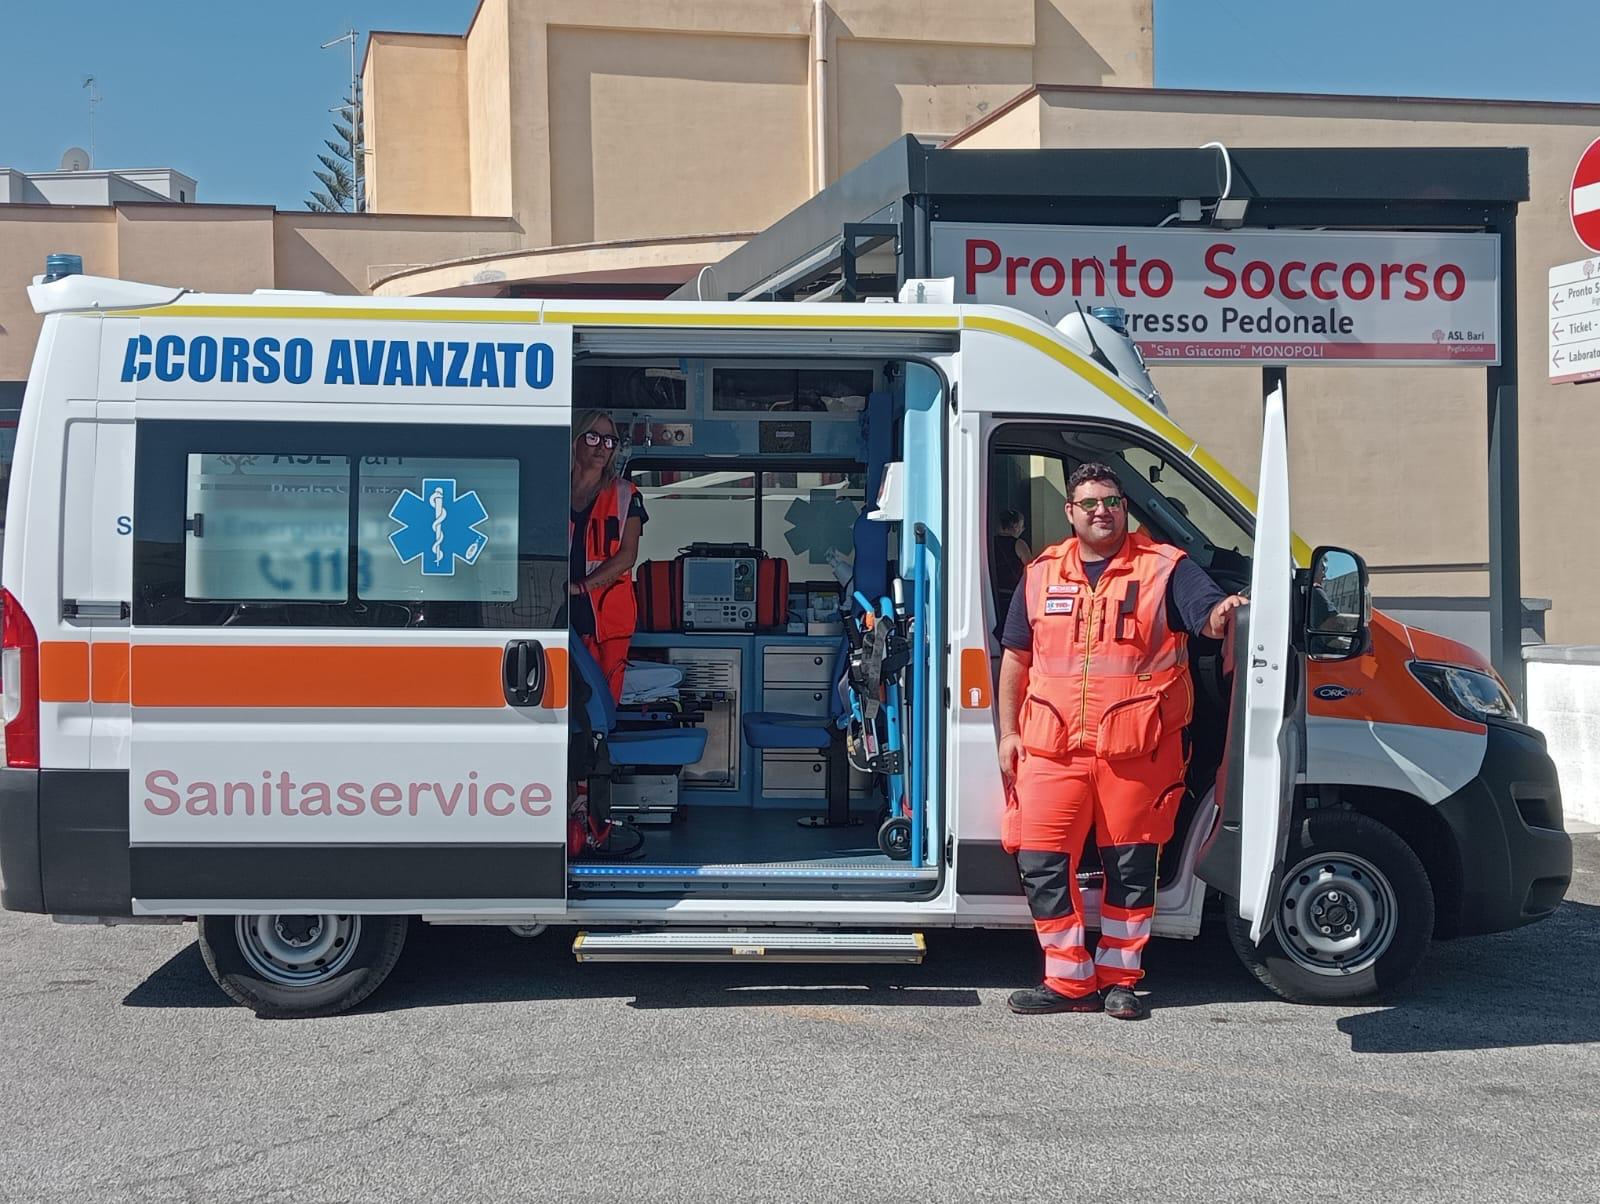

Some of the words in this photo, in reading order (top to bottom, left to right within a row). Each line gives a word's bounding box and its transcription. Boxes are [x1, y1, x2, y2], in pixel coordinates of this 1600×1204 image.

[965, 238, 1174, 299] Pronto
[1203, 243, 1467, 302] Soccorso
[1568, 285, 1593, 299] Pronto
[1087, 306, 1209, 333] resso
[1222, 307, 1354, 334] Pedonale
[1569, 321, 1592, 335] Ticket
[1447, 330, 1464, 341] ASL
[1467, 330, 1485, 341] Bari
[1251, 344, 1323, 358] MONOPOLI
[324, 339, 554, 390] AVANZATO
[144, 770, 552, 816] Sanitaservice
